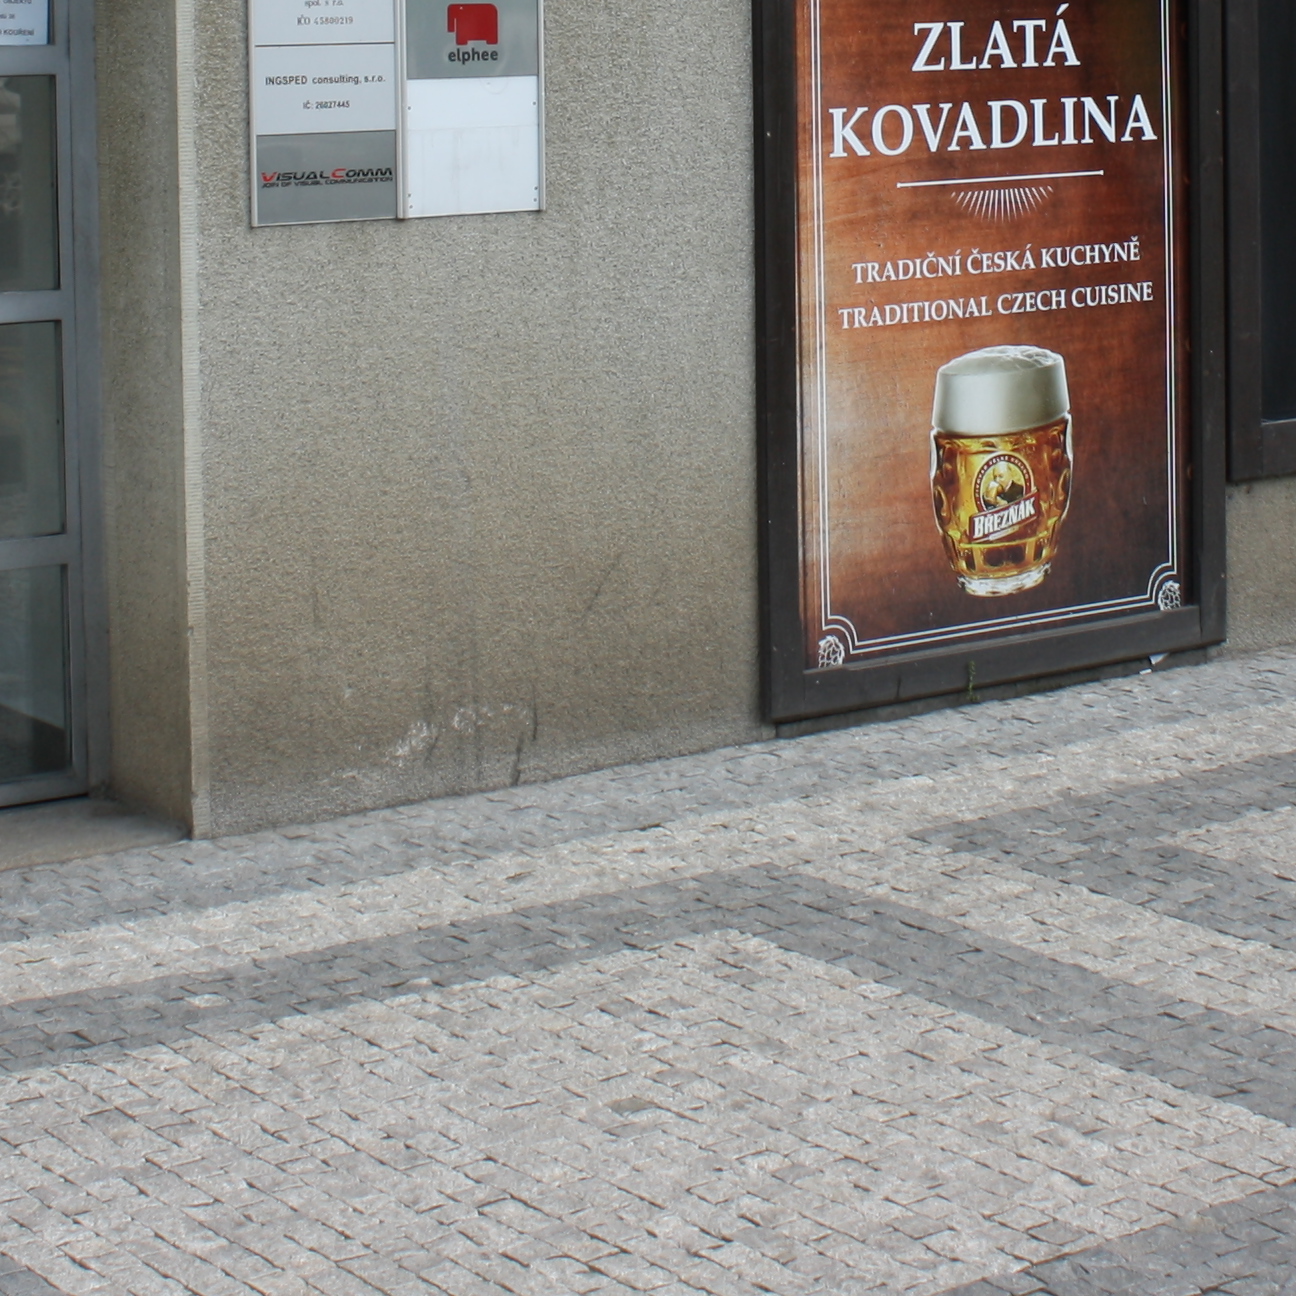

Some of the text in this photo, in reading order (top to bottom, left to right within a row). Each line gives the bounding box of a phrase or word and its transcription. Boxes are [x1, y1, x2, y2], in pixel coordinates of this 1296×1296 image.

[448, 48, 498, 65] elphee
[912, 2, 1081, 72] ZLATÁ
[265, 75, 308, 85] INGSPED
[829, 94, 1158, 158] KOVADLINA
[852, 236, 1141, 284] TRADIČNÍ ČESKÁ KUCHYNĚ
[838, 281, 1154, 330] TRADITIONAL CZECH CUISINE
